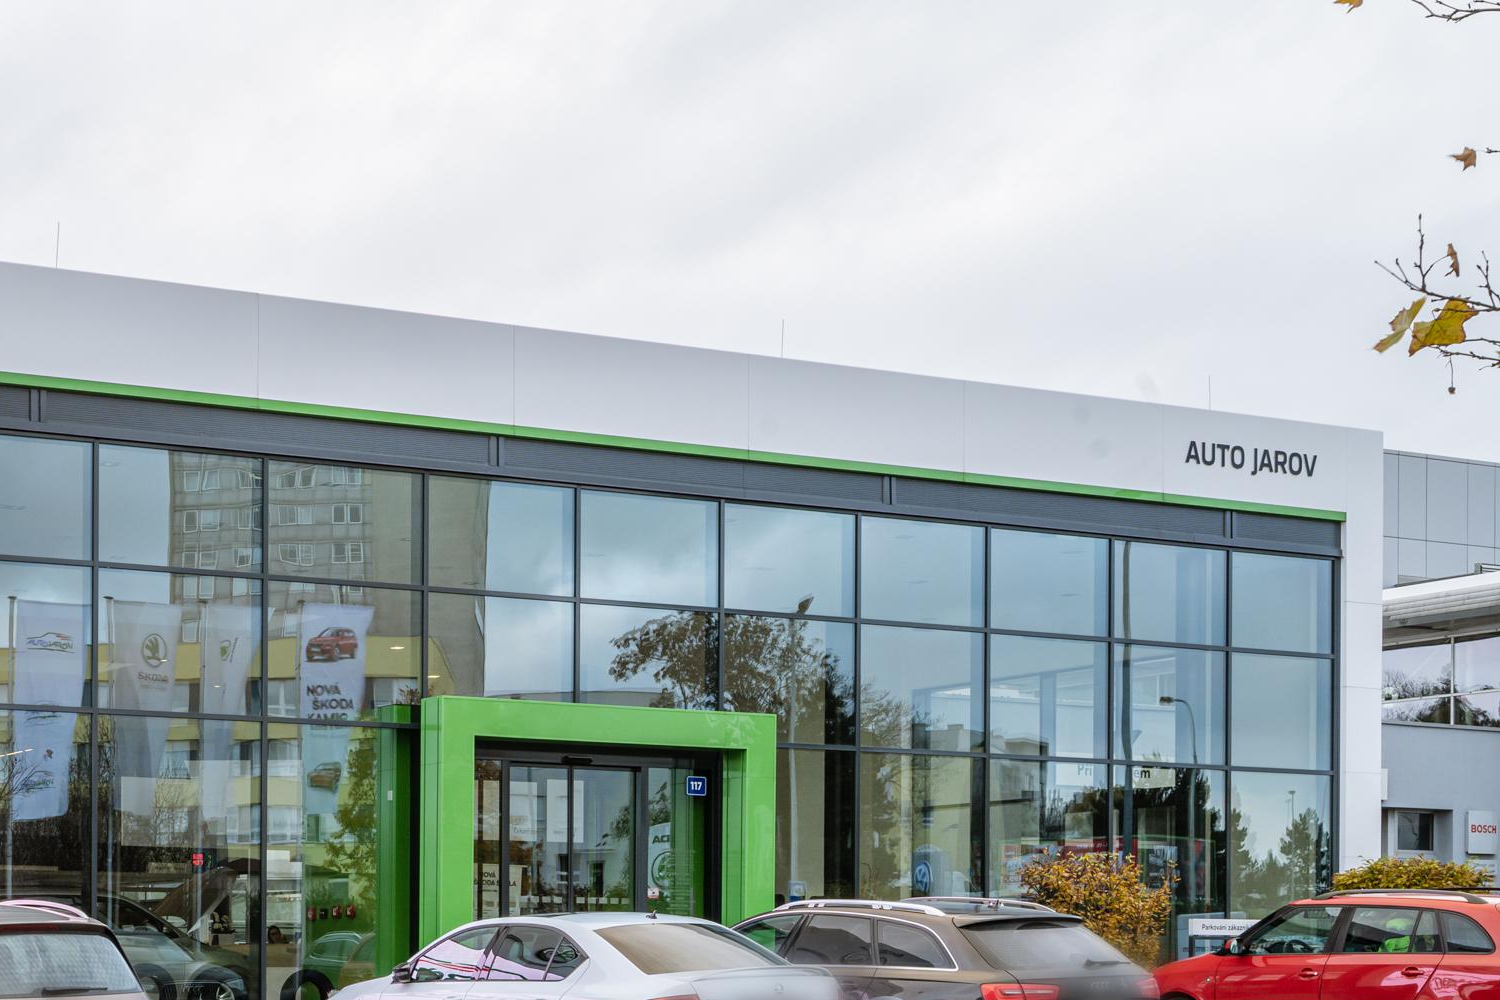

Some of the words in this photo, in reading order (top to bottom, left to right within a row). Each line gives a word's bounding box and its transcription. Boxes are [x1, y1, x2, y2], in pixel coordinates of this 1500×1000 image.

[1185, 440, 1245, 469] AUTO
[1251, 448, 1317, 477] JAROV
[690, 781, 703, 791] 117
[1471, 824, 1497, 834] BOSCH
